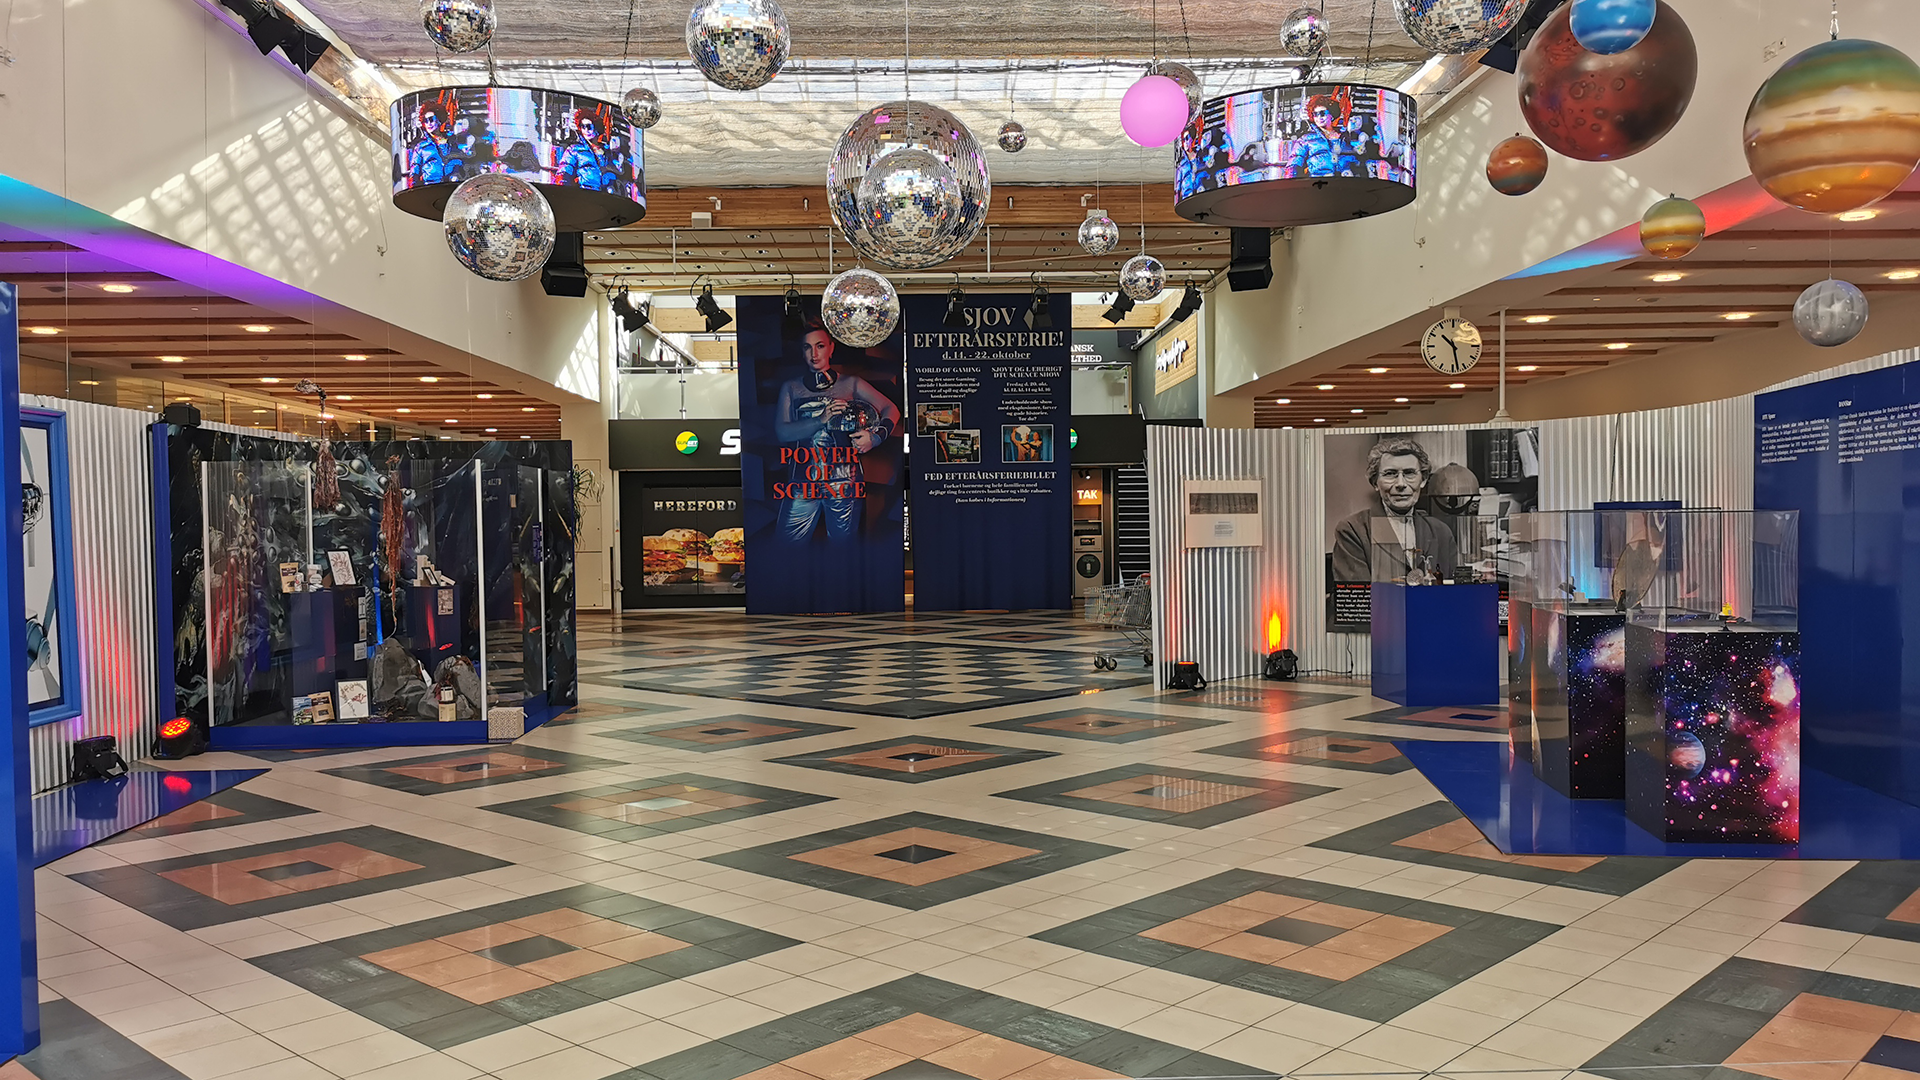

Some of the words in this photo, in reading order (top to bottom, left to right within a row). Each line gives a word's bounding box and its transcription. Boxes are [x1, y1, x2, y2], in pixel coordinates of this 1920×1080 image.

[963, 307, 1017, 328] SJOV
[913, 328, 1064, 348] EFTERÅRSFERIE!
[942, 351, 953, 359] d.
[954, 351, 966, 359] 14.
[975, 351, 990, 359] 22.
[992, 350, 1031, 359] oktober
[1070, 344, 1095, 353] ANSK
[1071, 354, 1103, 363] LTHED
[780, 446, 860, 464] POWER
[805, 465, 835, 482] OF
[924, 472, 943, 481] FED
[946, 470, 1057, 480] EFTERÅRSFERIEBILLET
[773, 482, 867, 500] SCIENCE
[1077, 489, 1098, 500] TAK
[653, 500, 737, 512] HEREFORD
